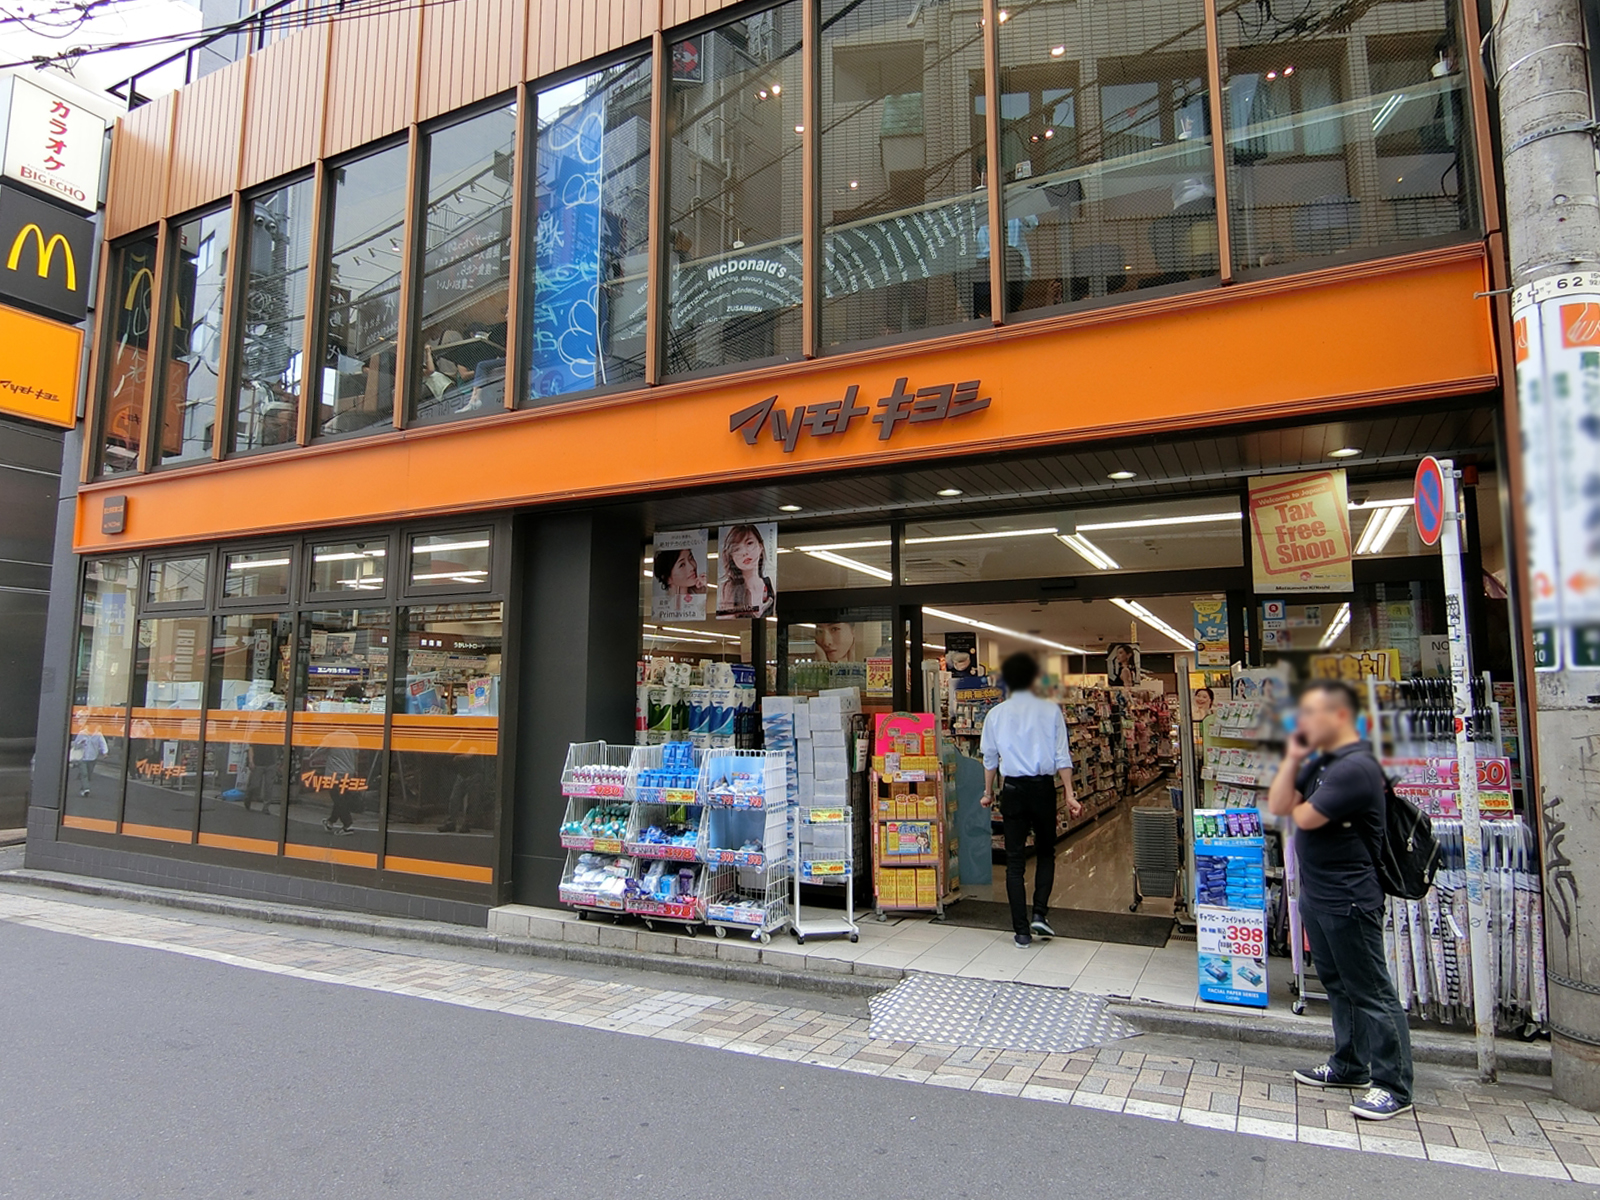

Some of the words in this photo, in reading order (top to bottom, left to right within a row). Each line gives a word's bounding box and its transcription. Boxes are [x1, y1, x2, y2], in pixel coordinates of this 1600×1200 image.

[43, 101, 70, 171] カラオケ
[20, 166, 47, 184] BIG
[49, 178, 86, 201] ECHO
[706, 259, 787, 281] McDonald's
[1557, 276, 1584, 289] 62
[726, 305, 763, 313] ZUSAMMEN
[729, 377, 992, 453] マツモトキヨシ
[1258, 493, 1291, 506] Welcome
[1274, 501, 1317, 524] Tax
[1275, 520, 1327, 544] Free
[1276, 538, 1336, 564] Shop
[660, 609, 696, 618] Primavista
[302, 770, 368, 794] マツモトキヨシ
[595, 785, 620, 796] 980
[665, 847, 693, 859] 398
[664, 904, 692, 917] 398
[1227, 925, 1263, 943] 398
